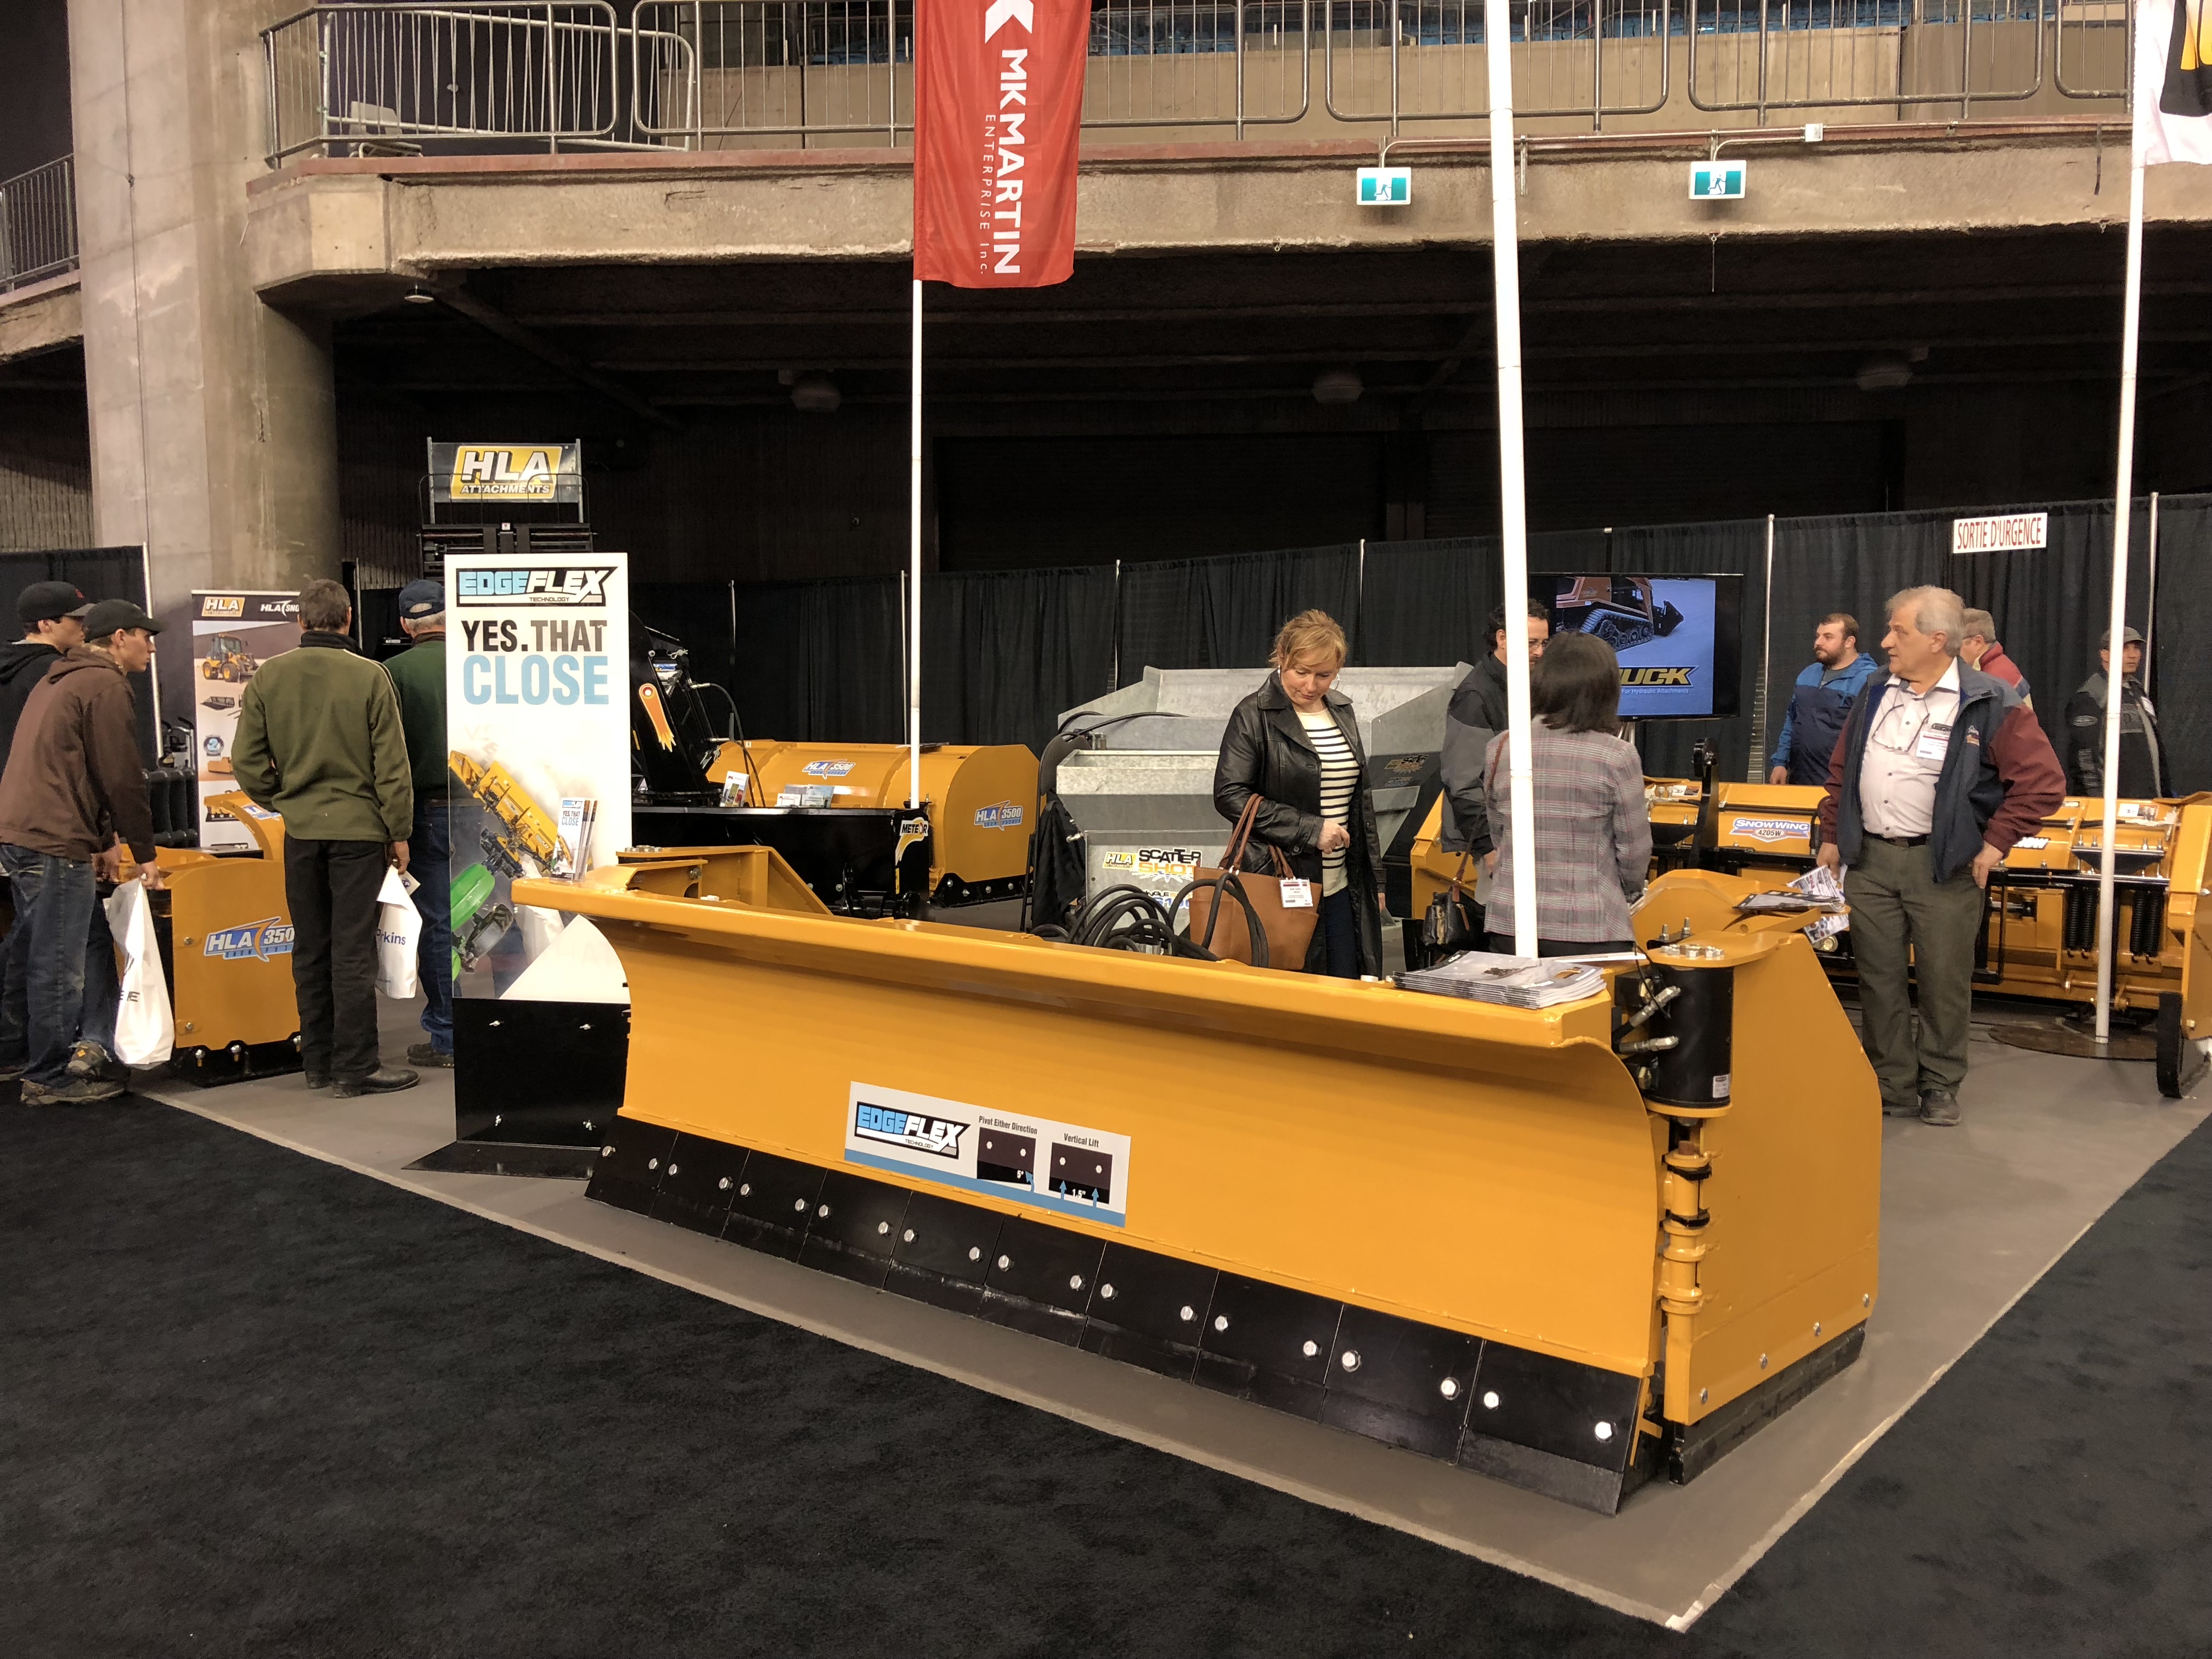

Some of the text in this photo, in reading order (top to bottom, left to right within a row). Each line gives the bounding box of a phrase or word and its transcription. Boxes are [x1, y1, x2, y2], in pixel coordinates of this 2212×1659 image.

[993, 48, 1028, 274] MKMARTIN
[979, 114, 996, 274] ENTERPRISE Inc.
[461, 450, 552, 482] HLA
[460, 484, 550, 495] ATTACHMENTS
[1957, 517, 2042, 550] SORTIE D'URGENCE
[459, 570, 610, 599] EDGEFLEX
[206, 599, 239, 611] HLA
[261, 603, 281, 612] HLA
[285, 604, 300, 612] SNO
[462, 654, 610, 706] CLOSE
[1620, 668, 1691, 685] UCK
[806, 762, 854, 771] HLA 3500
[562, 816, 579, 826] CLOSE
[975, 807, 1022, 822] HLA 3500
[901, 822, 928, 834] METEOR
[1757, 829, 1782, 837] 4205W
[1105, 853, 1133, 865] HLA
[208, 927, 295, 951] HLA 350
[857, 1104, 964, 1148] EDGEFLEX
[978, 1115, 1038, 1135] Pivot Either Direction
[905, 1138, 934, 1149] TECHNOLOGY
[1064, 1133, 1099, 1148] Vertical Lift
